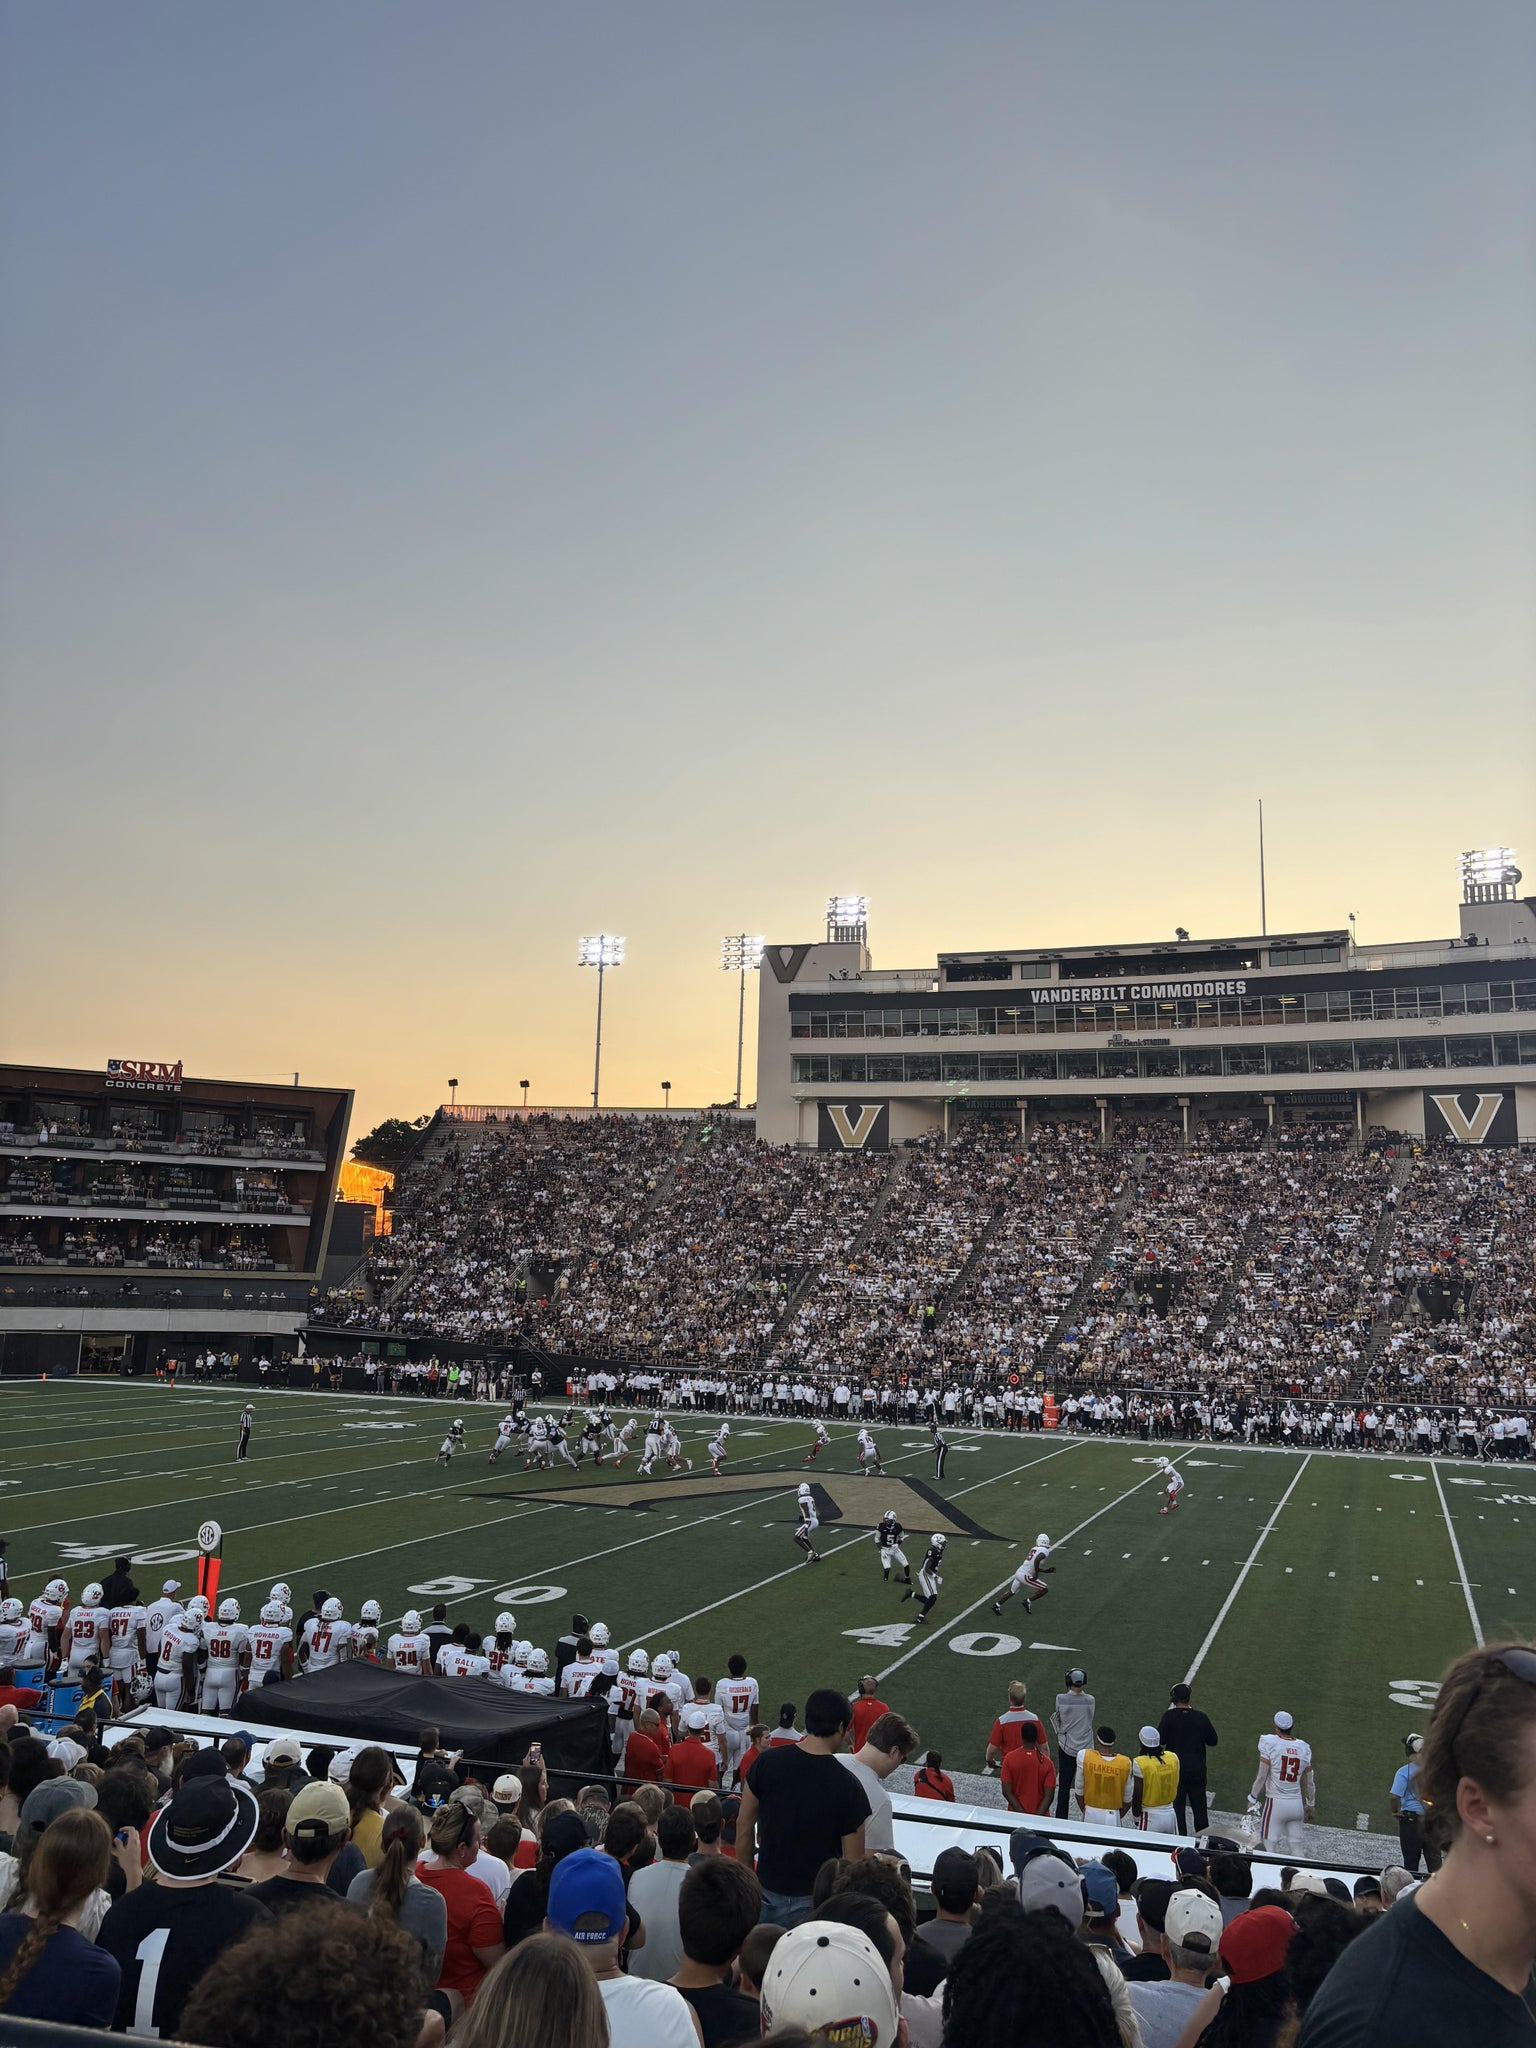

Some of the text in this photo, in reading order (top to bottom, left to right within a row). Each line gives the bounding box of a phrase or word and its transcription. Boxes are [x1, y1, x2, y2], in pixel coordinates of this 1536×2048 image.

[1031, 980, 1247, 1004] VANDERBILT COMMODORES
[120, 1060, 183, 1085] SRM
[105, 1080, 182, 1092] CONCRETE
[828, 1104, 885, 1148] V
[1429, 1093, 1504, 1143] V
[200, 1525, 214, 1545] SEC
[886, 1534, 895, 1546] 5
[74, 1620, 95, 1639] 23
[111, 1619, 128, 1637] 97
[150, 1612, 164, 1632] SEC
[163, 1630, 182, 1645] BROWN
[254, 1632, 280, 1640] HOWARD
[311, 1632, 333, 1654] 47
[162, 1641, 173, 1662] 8
[210, 1639, 231, 1659] 98
[255, 1640, 273, 1660] 13
[396, 1650, 418, 1666] 34
[454, 1657, 475, 1668] BALL
[489, 1651, 510, 1671] 26
[732, 1695, 750, 1714] 17
[1280, 1755, 1300, 1782] 13
[574, 1931, 607, 1940] AIR FORCE
[126, 1928, 171, 2038] 1
[828, 2024, 862, 2043] NBA
